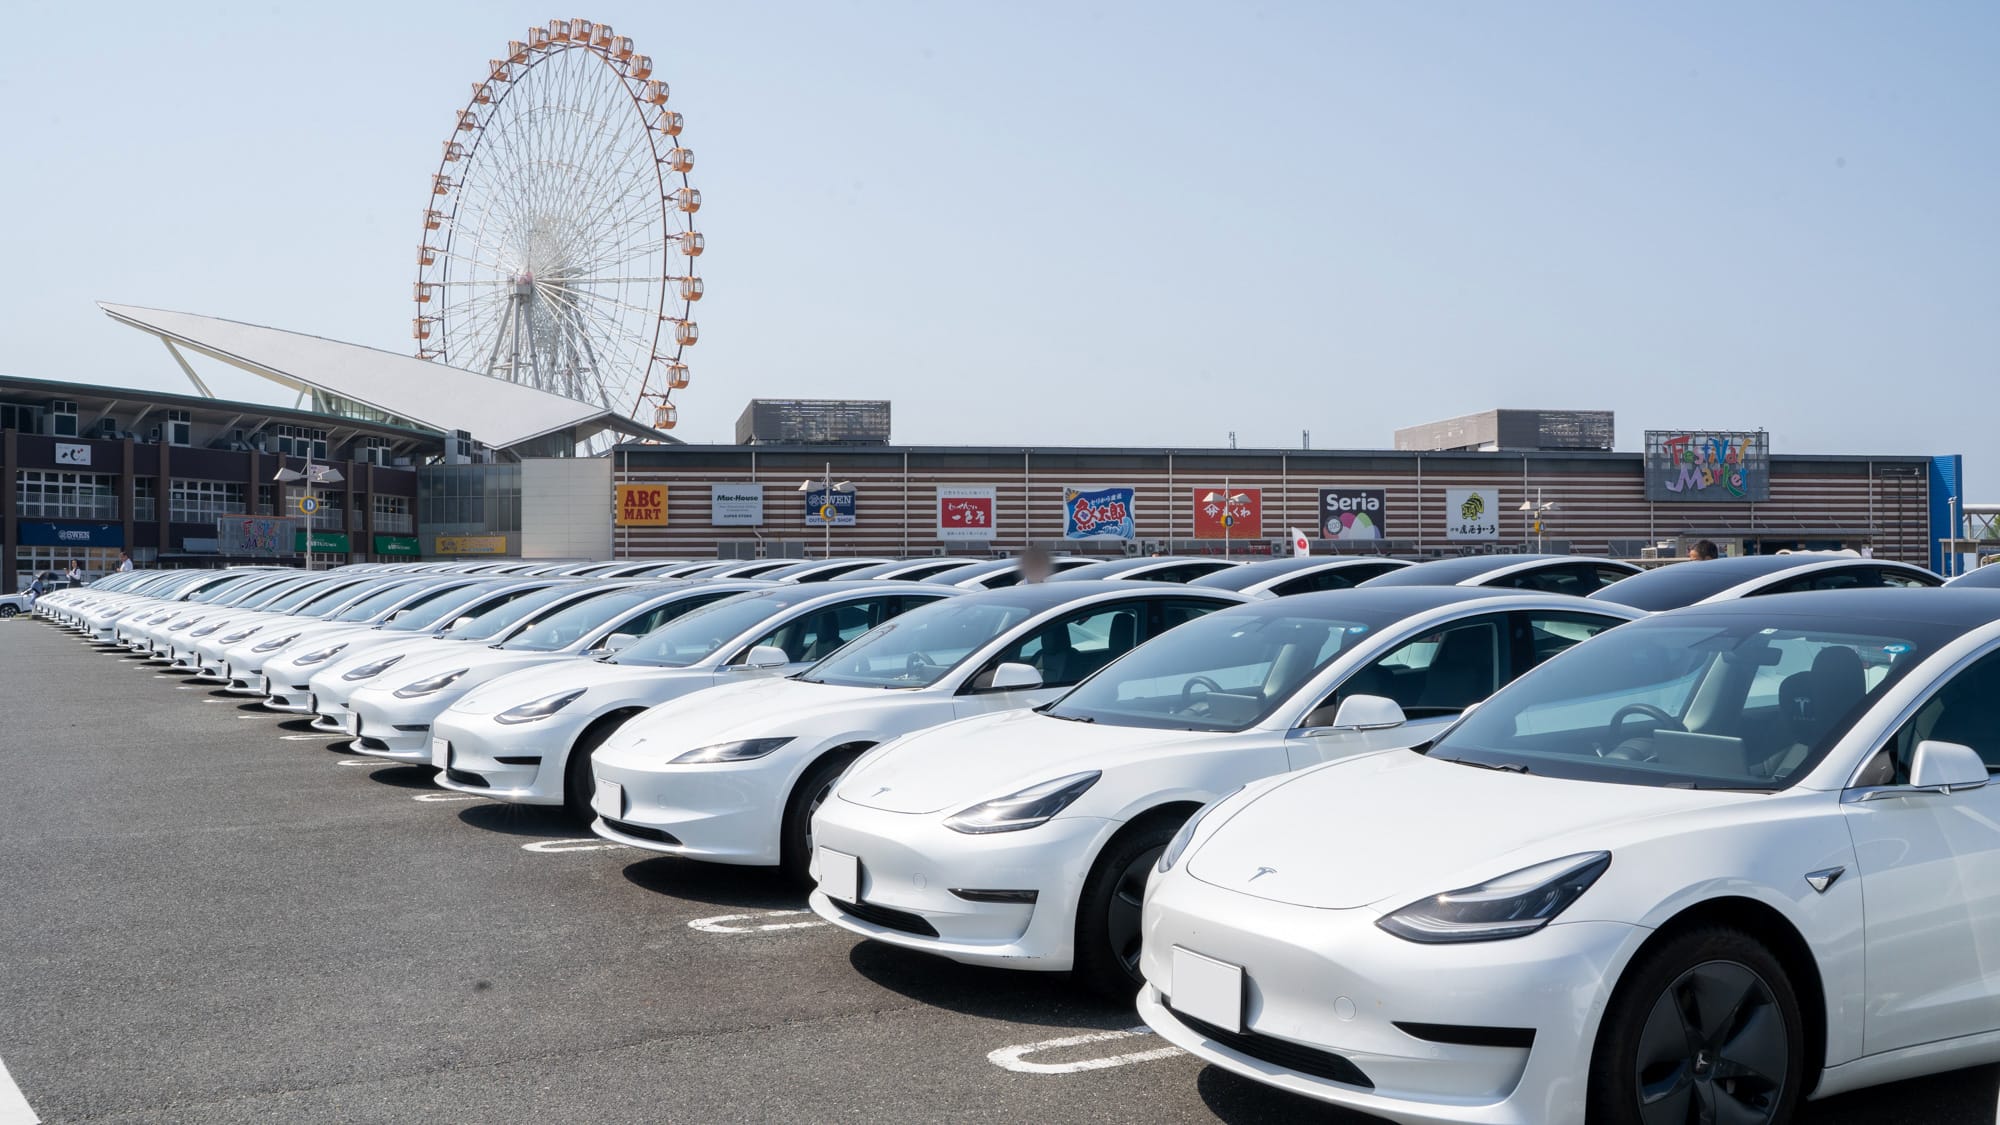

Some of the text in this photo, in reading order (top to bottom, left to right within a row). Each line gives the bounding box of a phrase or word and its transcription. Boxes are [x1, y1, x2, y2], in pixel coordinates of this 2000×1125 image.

[1664, 435, 1752, 466] Festival
[1665, 464, 1749, 496] Market
[307, 500, 314, 509] D
[624, 490, 661, 507] ABC
[717, 494, 759, 502] Mac-House
[820, 495, 853, 505] SWEN
[1326, 492, 1380, 511] Seria
[624, 508, 661, 520] MART
[1073, 498, 1125, 531] 魚太郎
